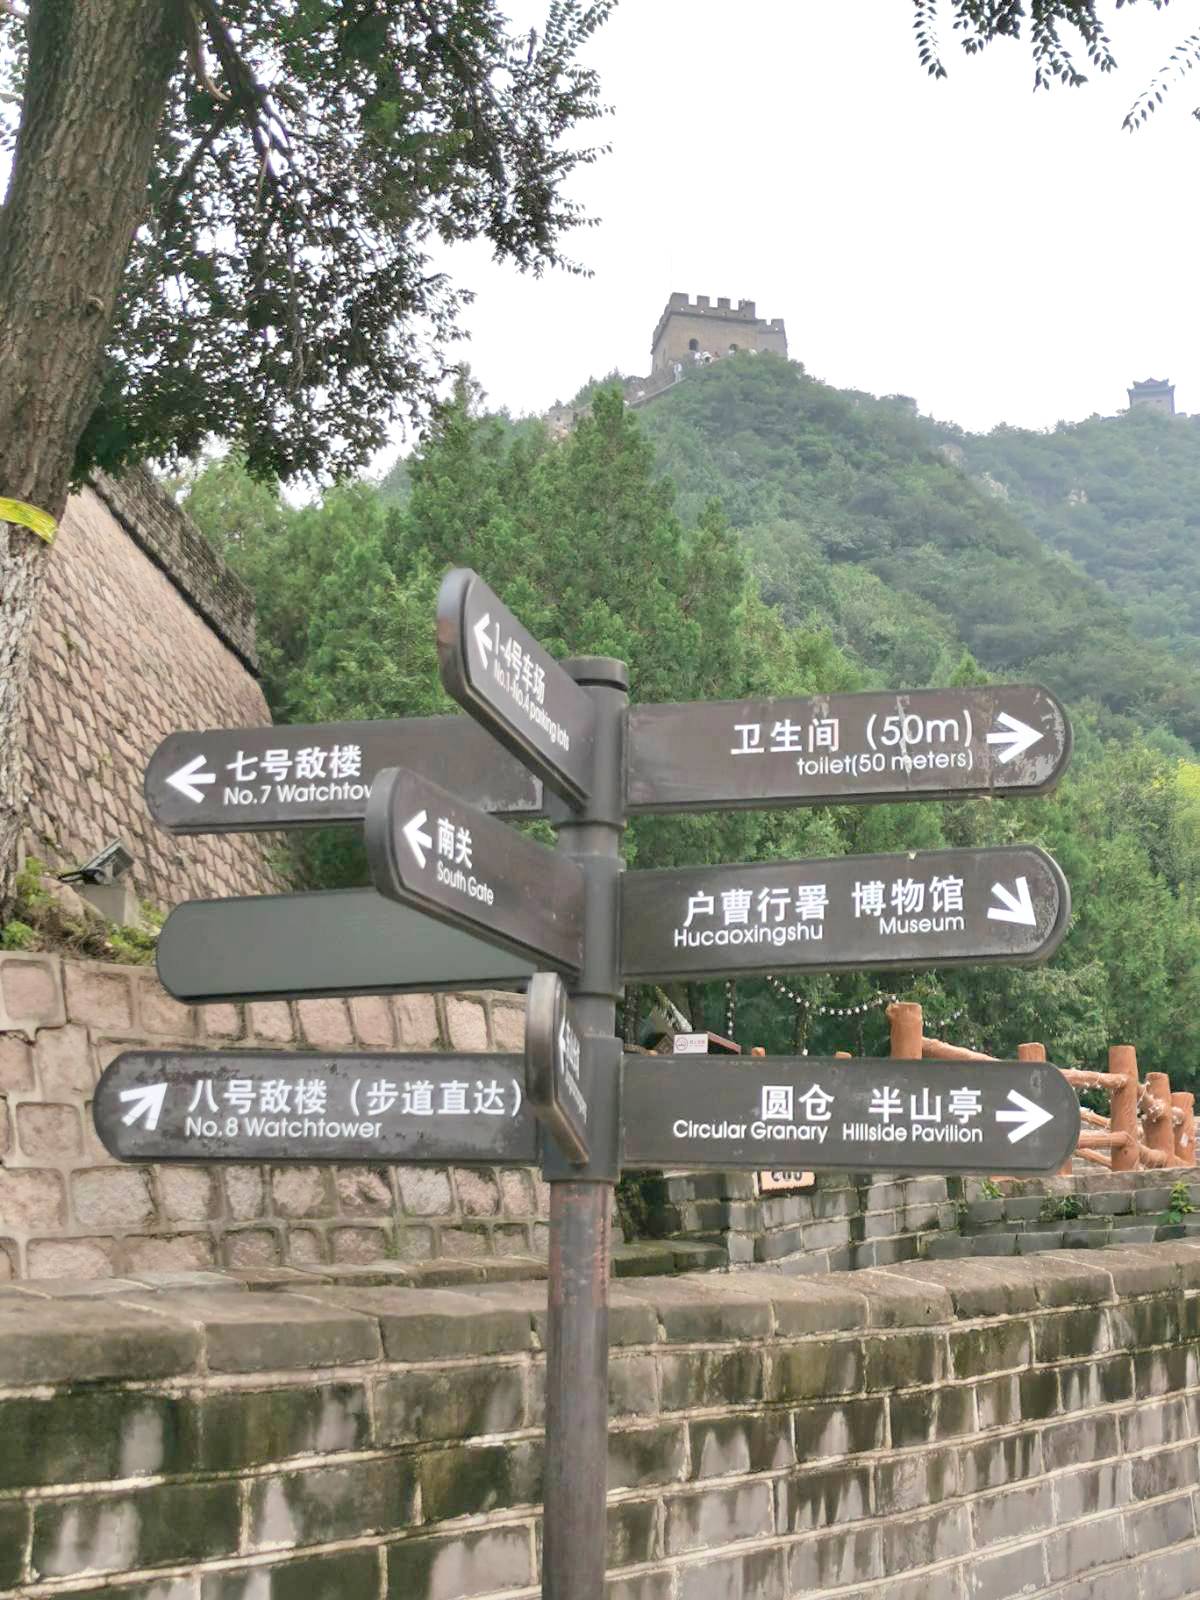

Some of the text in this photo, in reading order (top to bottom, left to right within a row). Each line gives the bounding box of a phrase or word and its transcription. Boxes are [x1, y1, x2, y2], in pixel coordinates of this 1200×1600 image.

[494, 622, 545, 705] 1-4号车场
[556, 723, 571, 753] lots
[225, 744, 363, 783] 七号敌楼
[796, 749, 974, 777] toilet(50 meters)
[223, 785, 273, 806] No.7
[437, 817, 474, 871] 南关
[437, 860, 495, 906] South Gate
[683, 874, 966, 928] 户曹行署 博物馆
[673, 913, 966, 948] Hucaoxingshu Museum
[760, 1083, 984, 1124] 圆仓 半山亭
[185, 1114, 384, 1139] No.8 Watchtower
[672, 1119, 984, 1144] Circular Granary Hillside Pavilion
